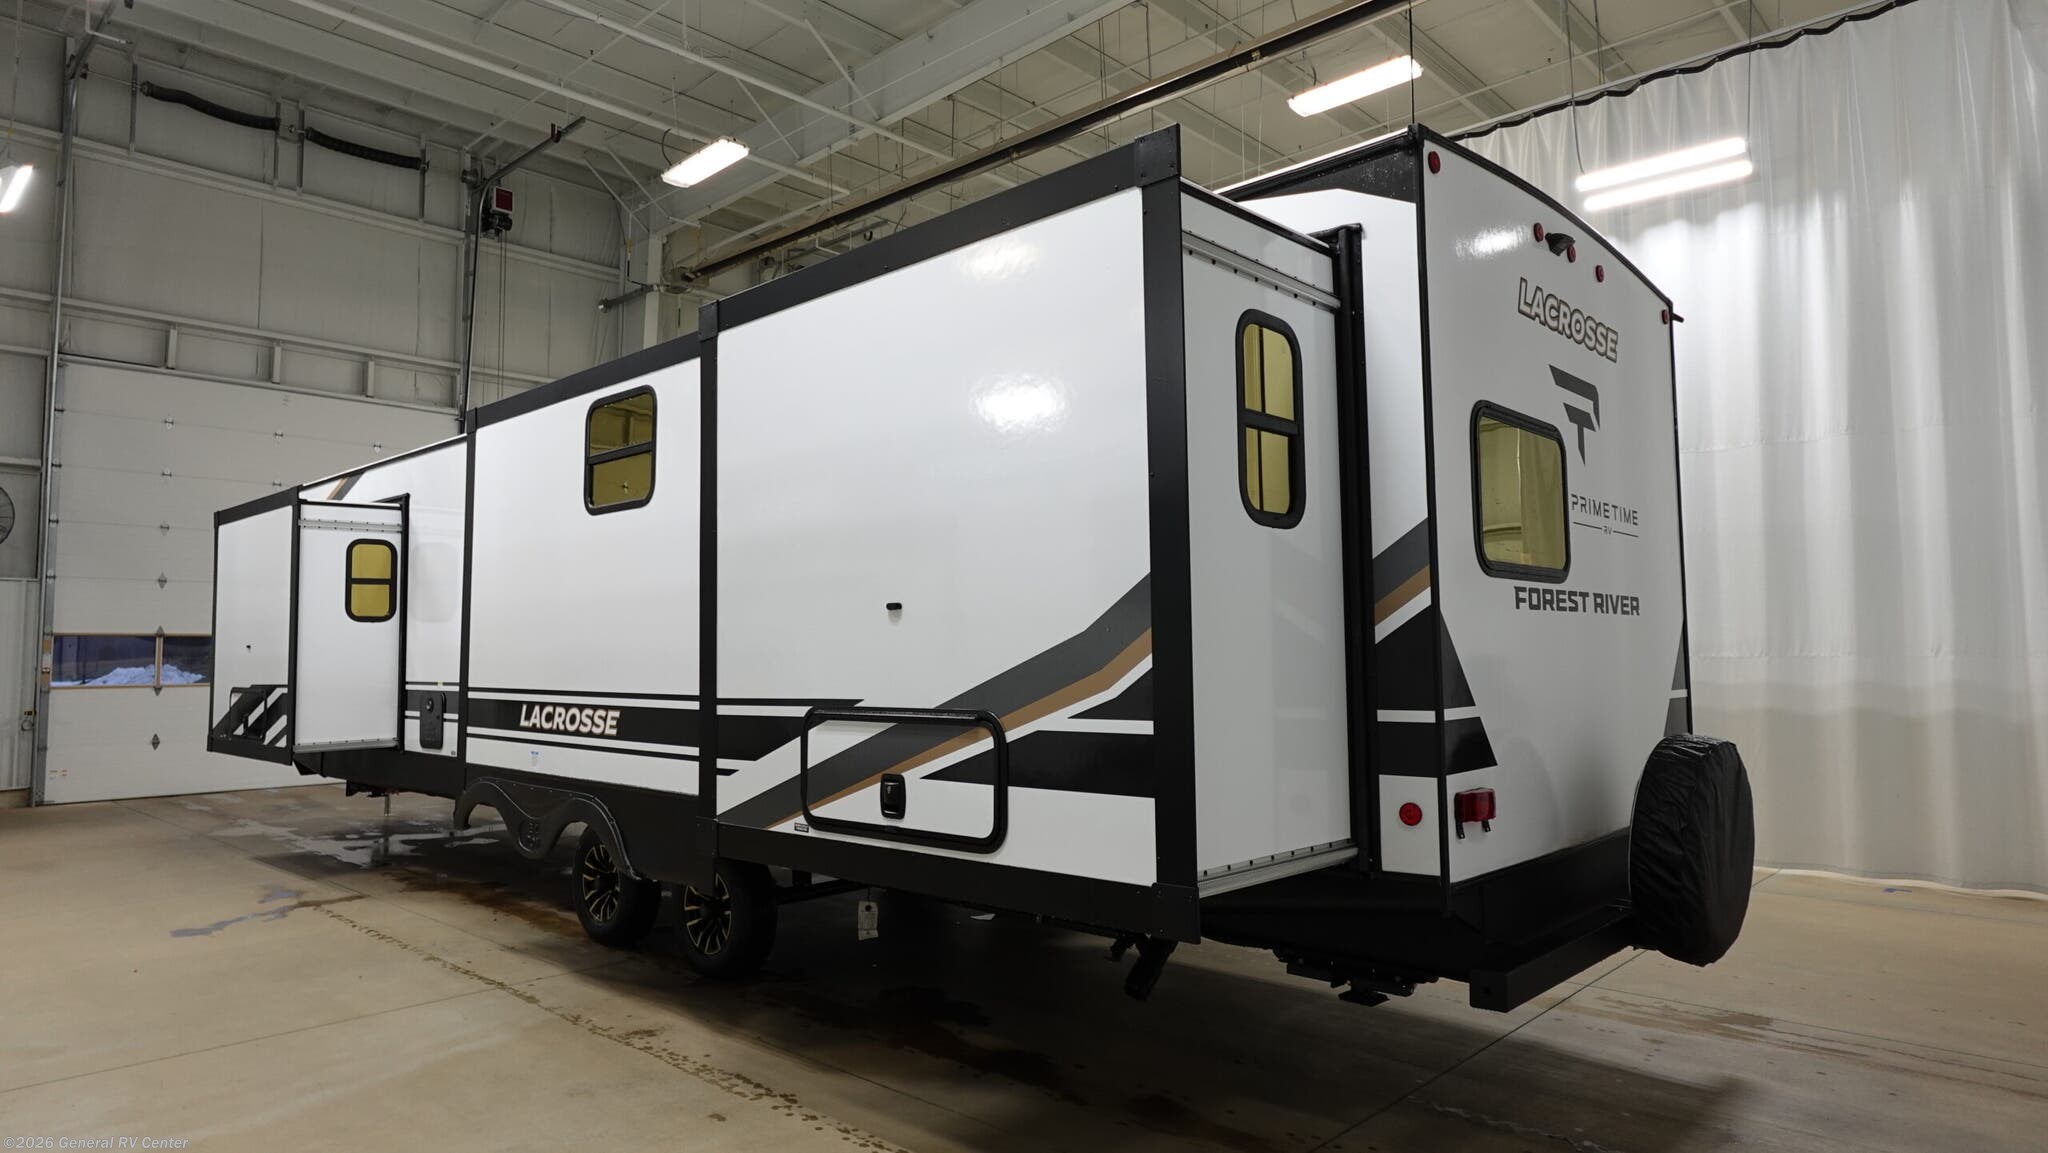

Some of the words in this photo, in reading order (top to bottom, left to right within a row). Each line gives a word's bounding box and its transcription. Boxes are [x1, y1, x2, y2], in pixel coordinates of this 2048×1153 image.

[1518, 276, 1619, 364] LACROSSE
[1514, 586, 1589, 613] FOREST
[1592, 592, 1640, 616] RIVER
[519, 704, 620, 736] LACROSSE
